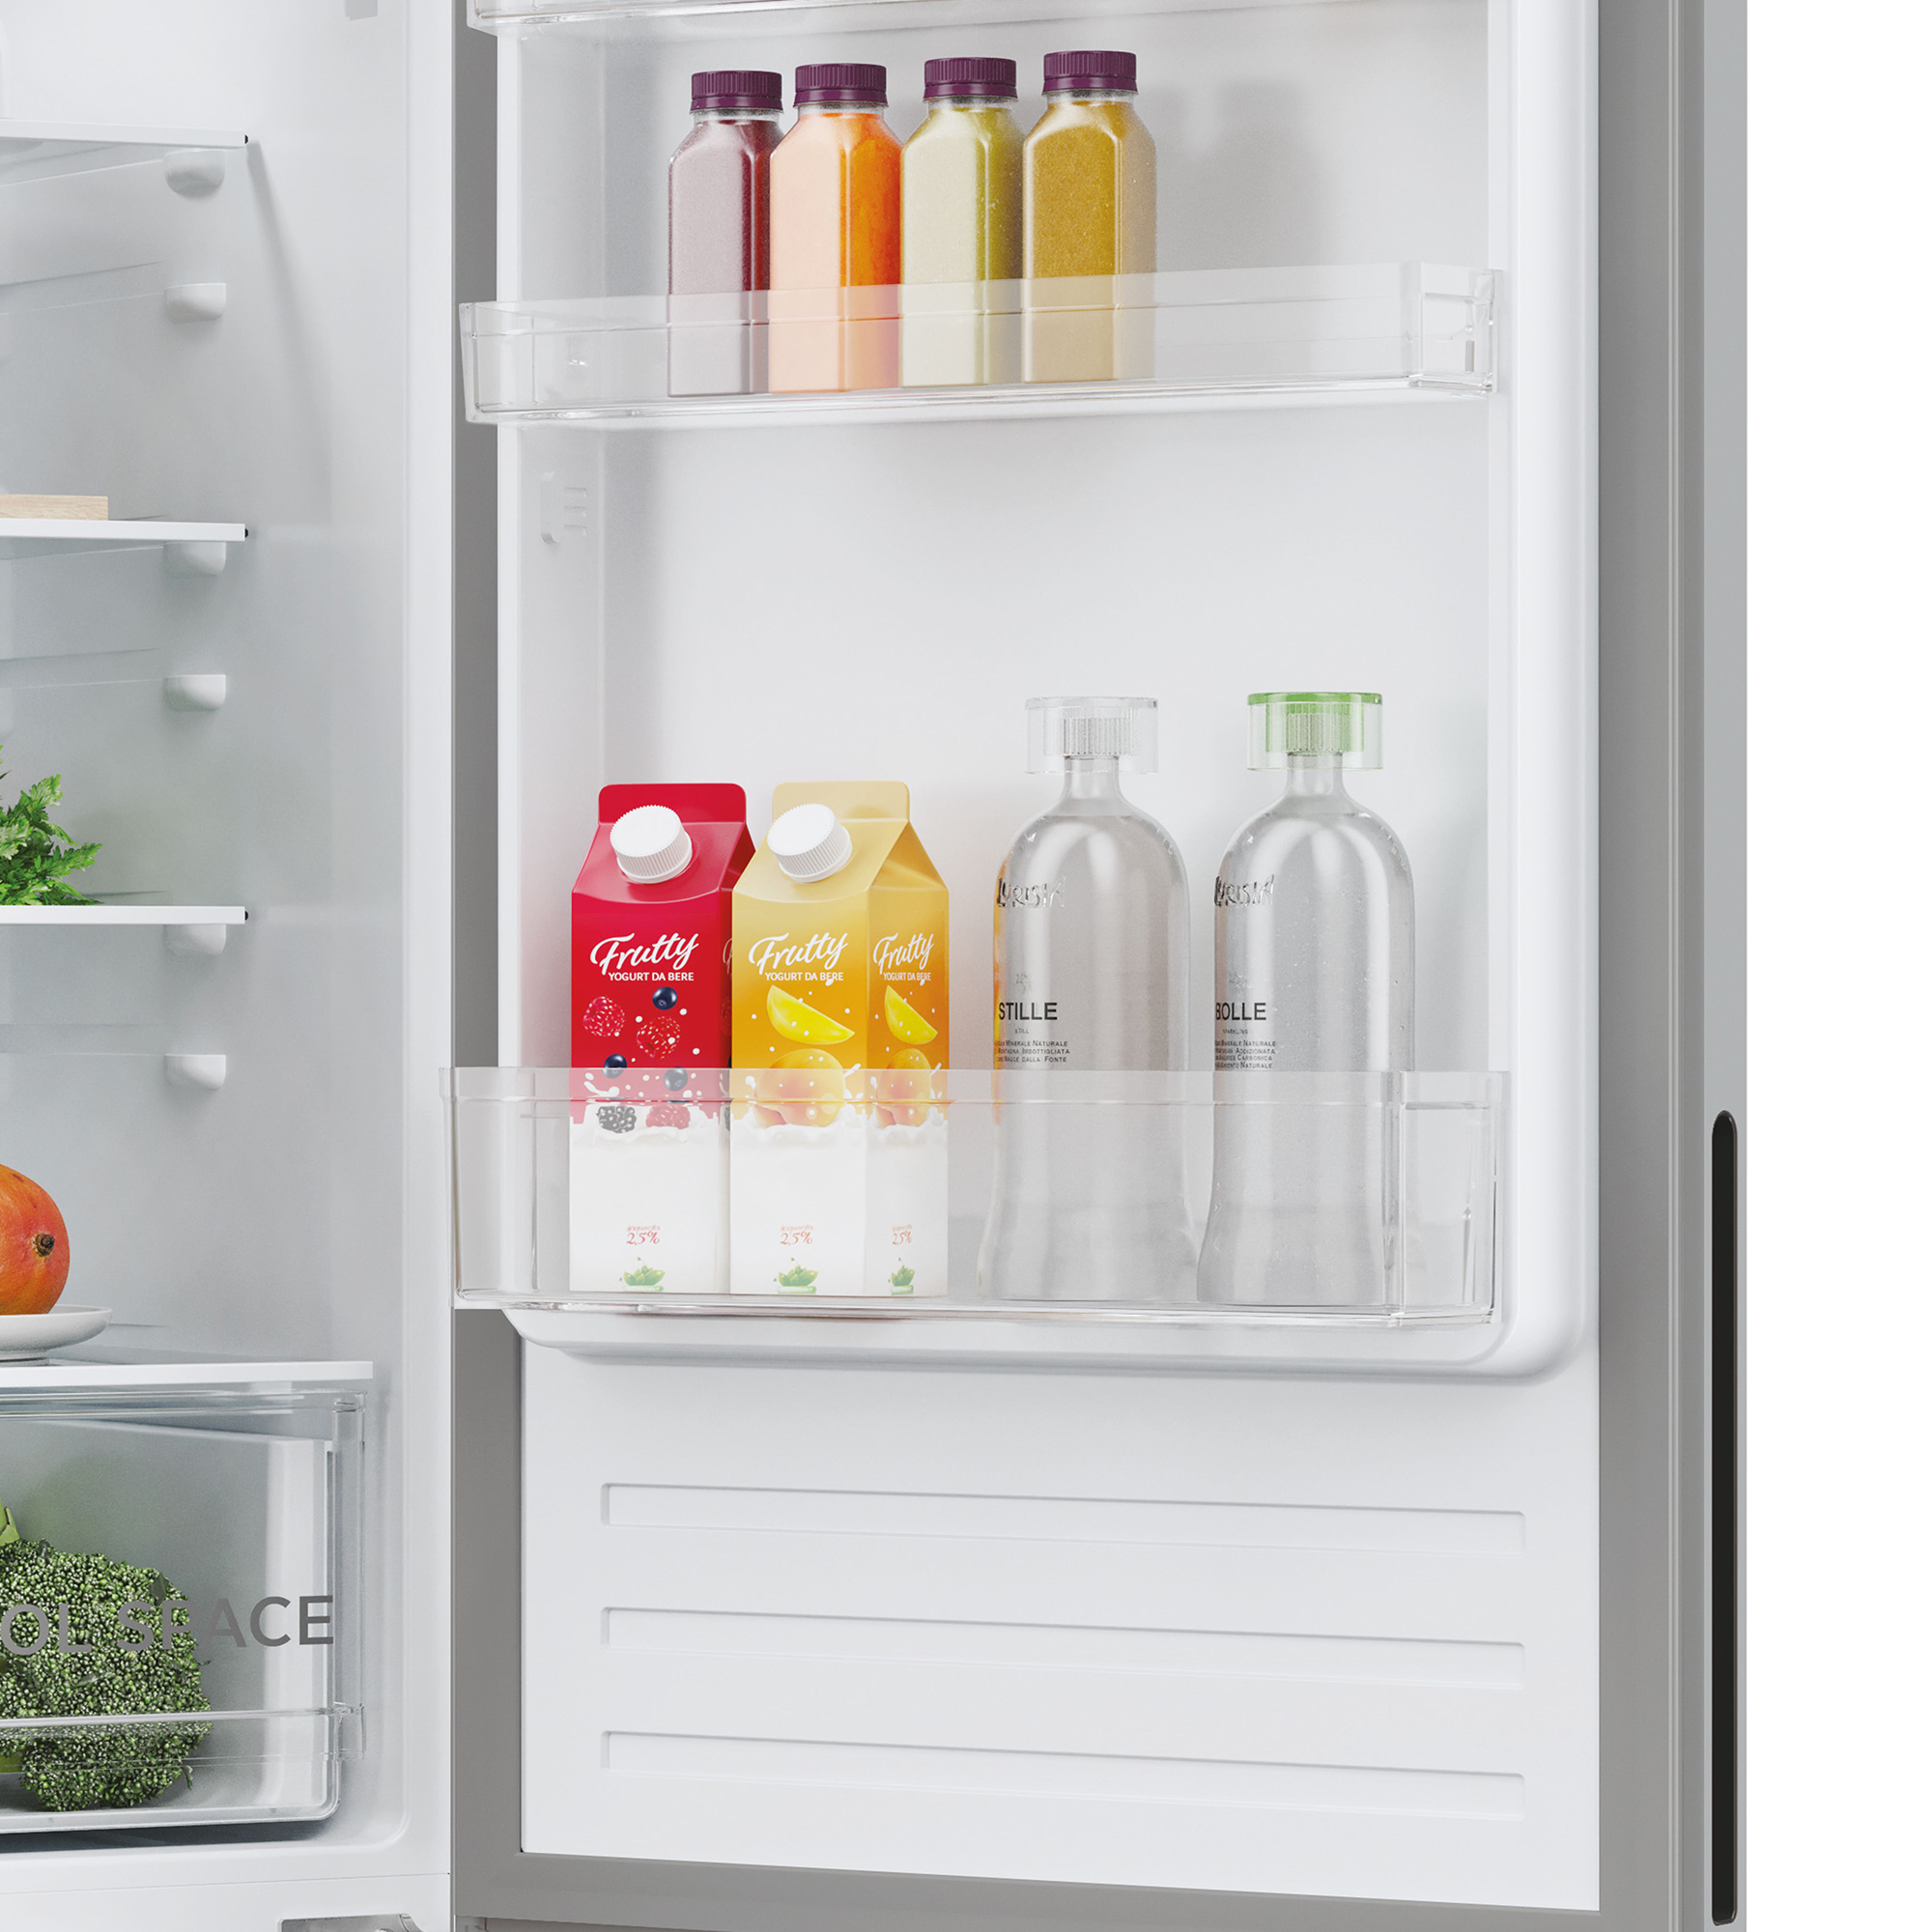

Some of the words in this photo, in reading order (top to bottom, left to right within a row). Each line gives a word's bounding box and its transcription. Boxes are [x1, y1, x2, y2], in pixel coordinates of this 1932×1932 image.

[590, 932, 699, 976] Frutty
[748, 932, 849, 976] Frutty
[872, 932, 934, 976] Frutty
[609, 972, 650, 981] YOGURT
[651, 972, 667, 981] DA
[668, 972, 695, 981] BERE
[765, 972, 804, 981] YOGURT
[805, 972, 818, 981] DA
[819, 972, 844, 981] BERE
[883, 972, 907, 981] YOGURT
[907, 972, 916, 981] DA
[917, 972, 932, 981] BERE
[998, 1002, 1058, 1020] STILLE
[1215, 1002, 1266, 1020] BOLLE
[116, 1595, 334, 1652] SPACE
